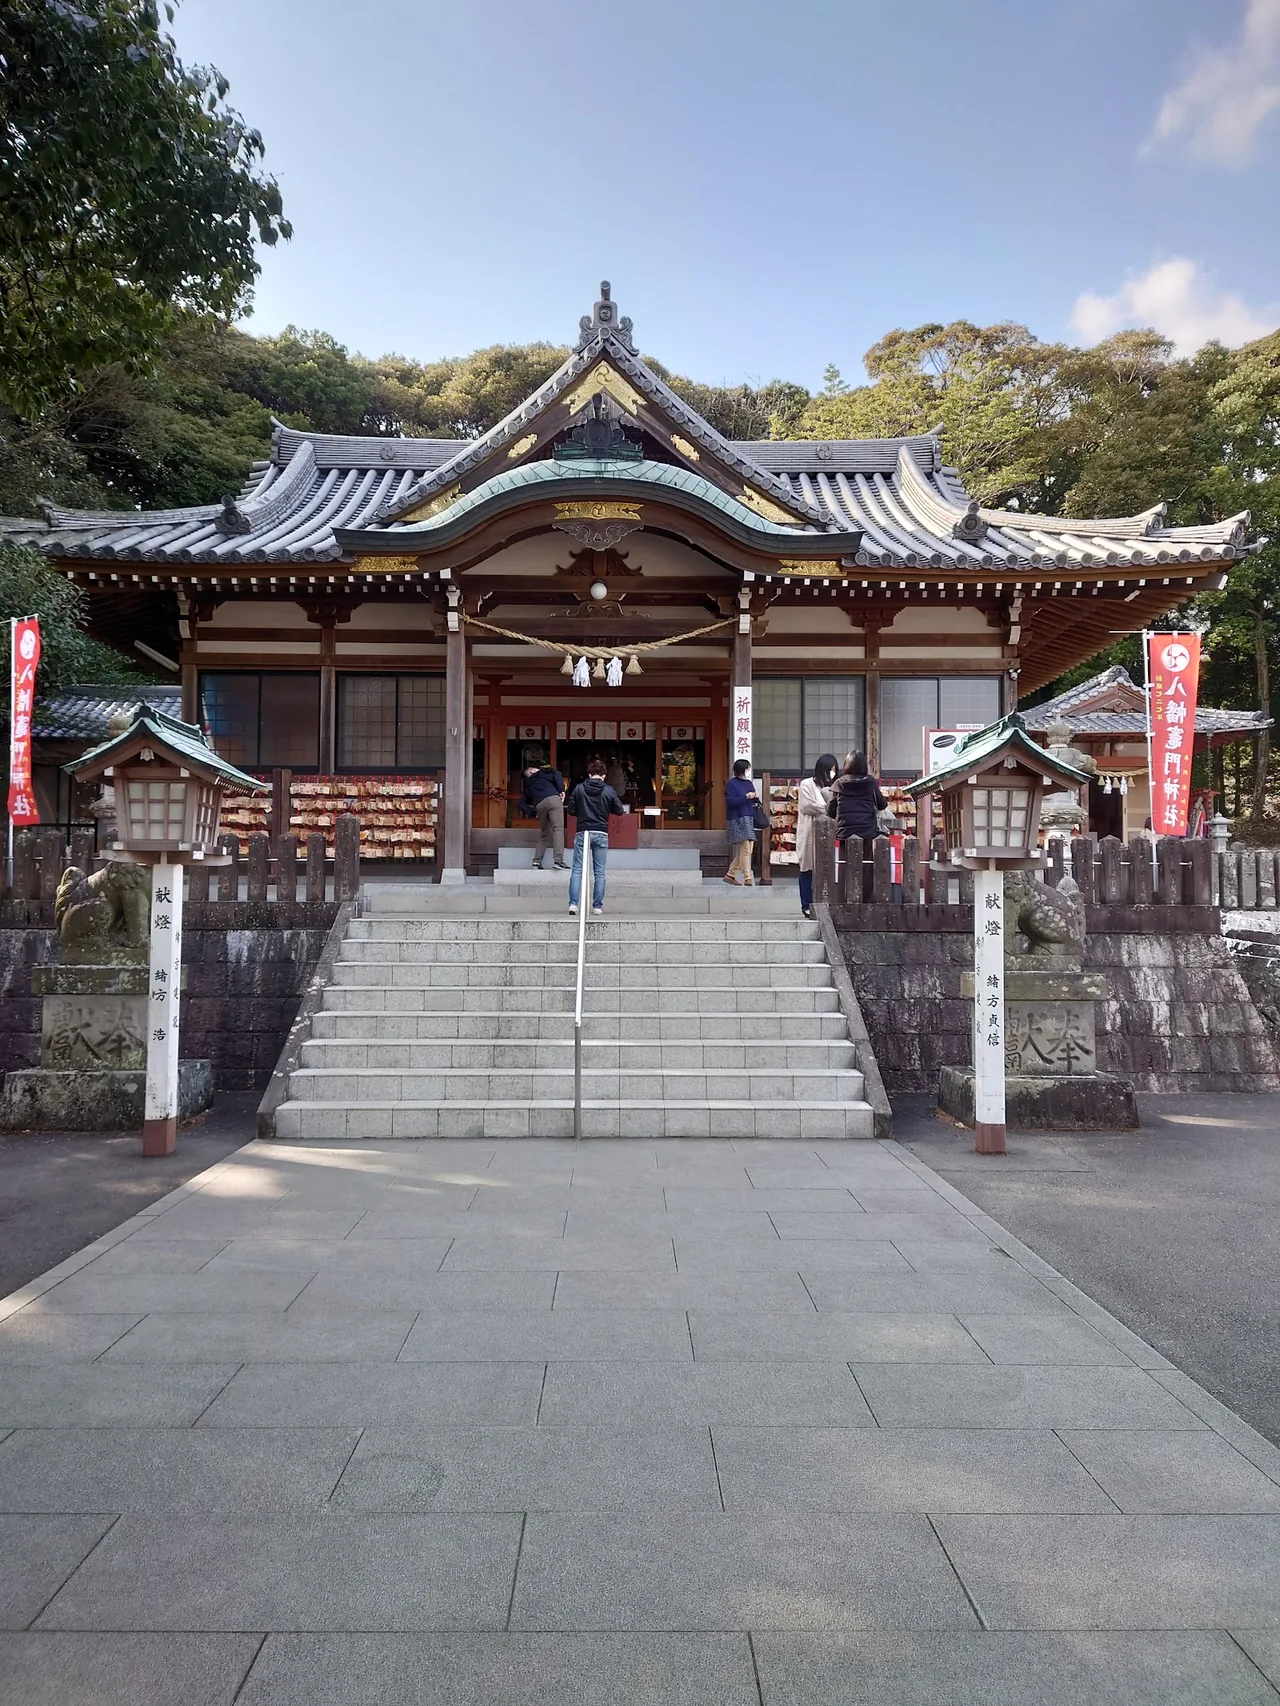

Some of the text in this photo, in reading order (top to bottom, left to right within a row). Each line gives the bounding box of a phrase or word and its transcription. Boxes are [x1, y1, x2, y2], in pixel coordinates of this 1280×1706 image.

[736, 696, 751, 755] 祈願祭
[154, 886, 173, 930] 献燈
[985, 893, 1002, 936] 献燈
[986, 974, 1001, 1047] 緒方貞信
